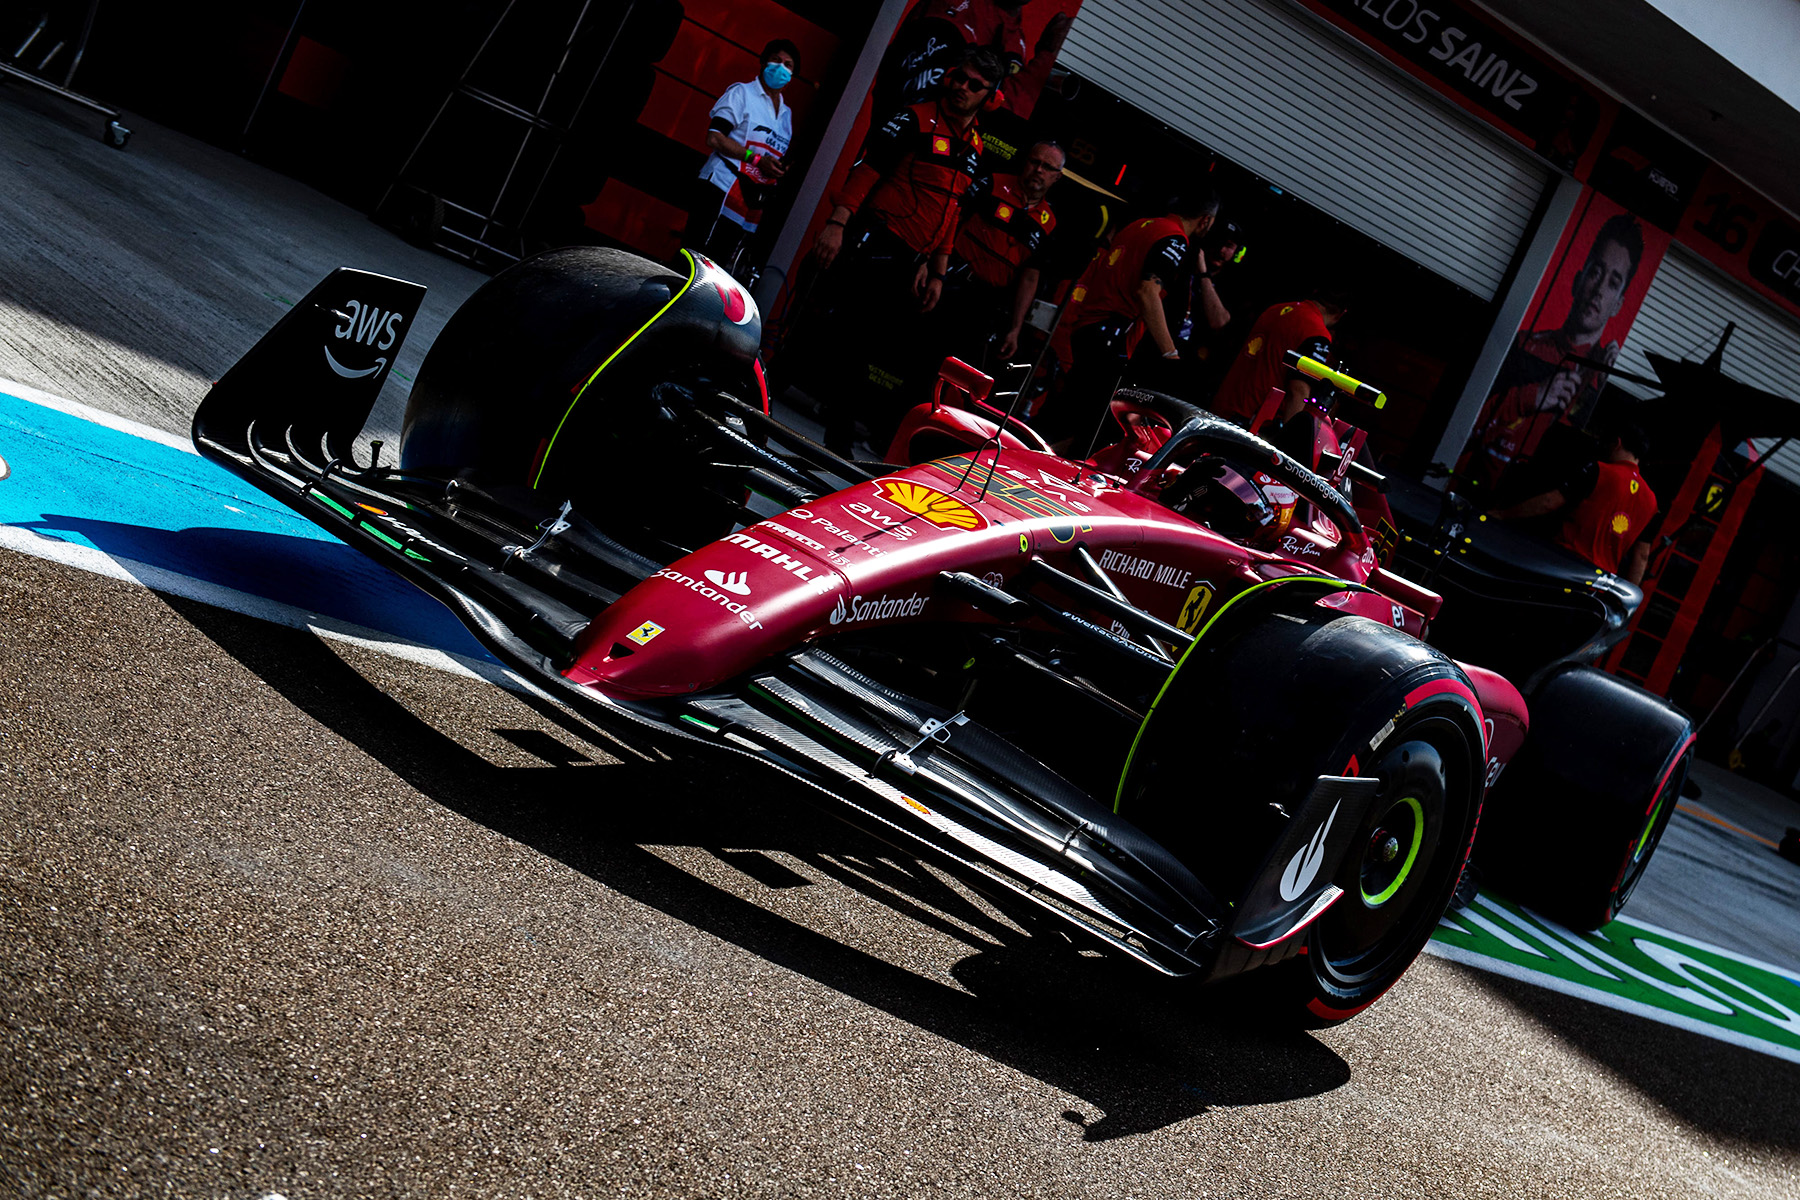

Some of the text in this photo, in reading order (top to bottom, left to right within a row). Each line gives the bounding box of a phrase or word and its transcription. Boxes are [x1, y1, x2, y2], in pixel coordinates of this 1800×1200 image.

[1428, 26, 1539, 111] SAINZ
[335, 299, 403, 351] aws
[1284, 459, 1339, 504] Snapdragon
[848, 502, 917, 537] aws
[1282, 535, 1321, 557] Ray-Ban
[1099, 549, 1192, 590] RICHARD MILLE
[651, 567, 763, 631] Santander
[846, 591, 931, 623] Santander
